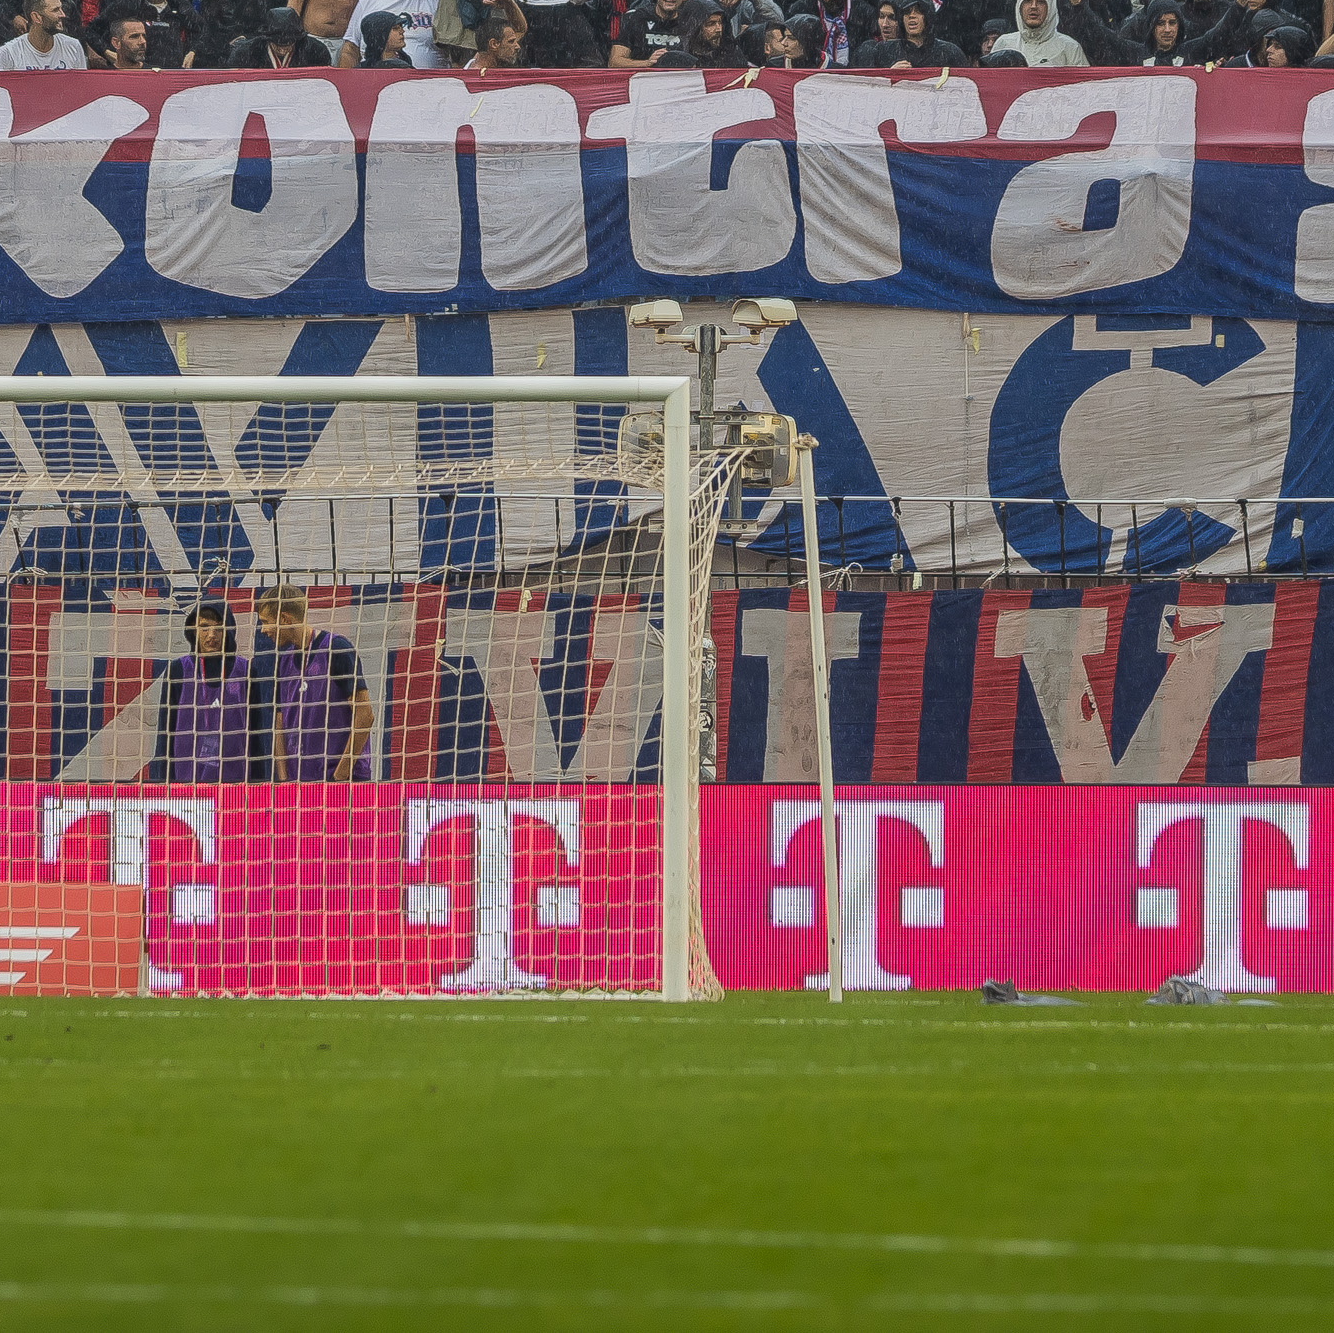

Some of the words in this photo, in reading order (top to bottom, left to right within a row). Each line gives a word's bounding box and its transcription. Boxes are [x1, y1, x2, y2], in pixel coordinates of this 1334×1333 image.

[407, 798, 580, 990] T
[771, 799, 944, 991] T
[1137, 802, 1309, 992] T
